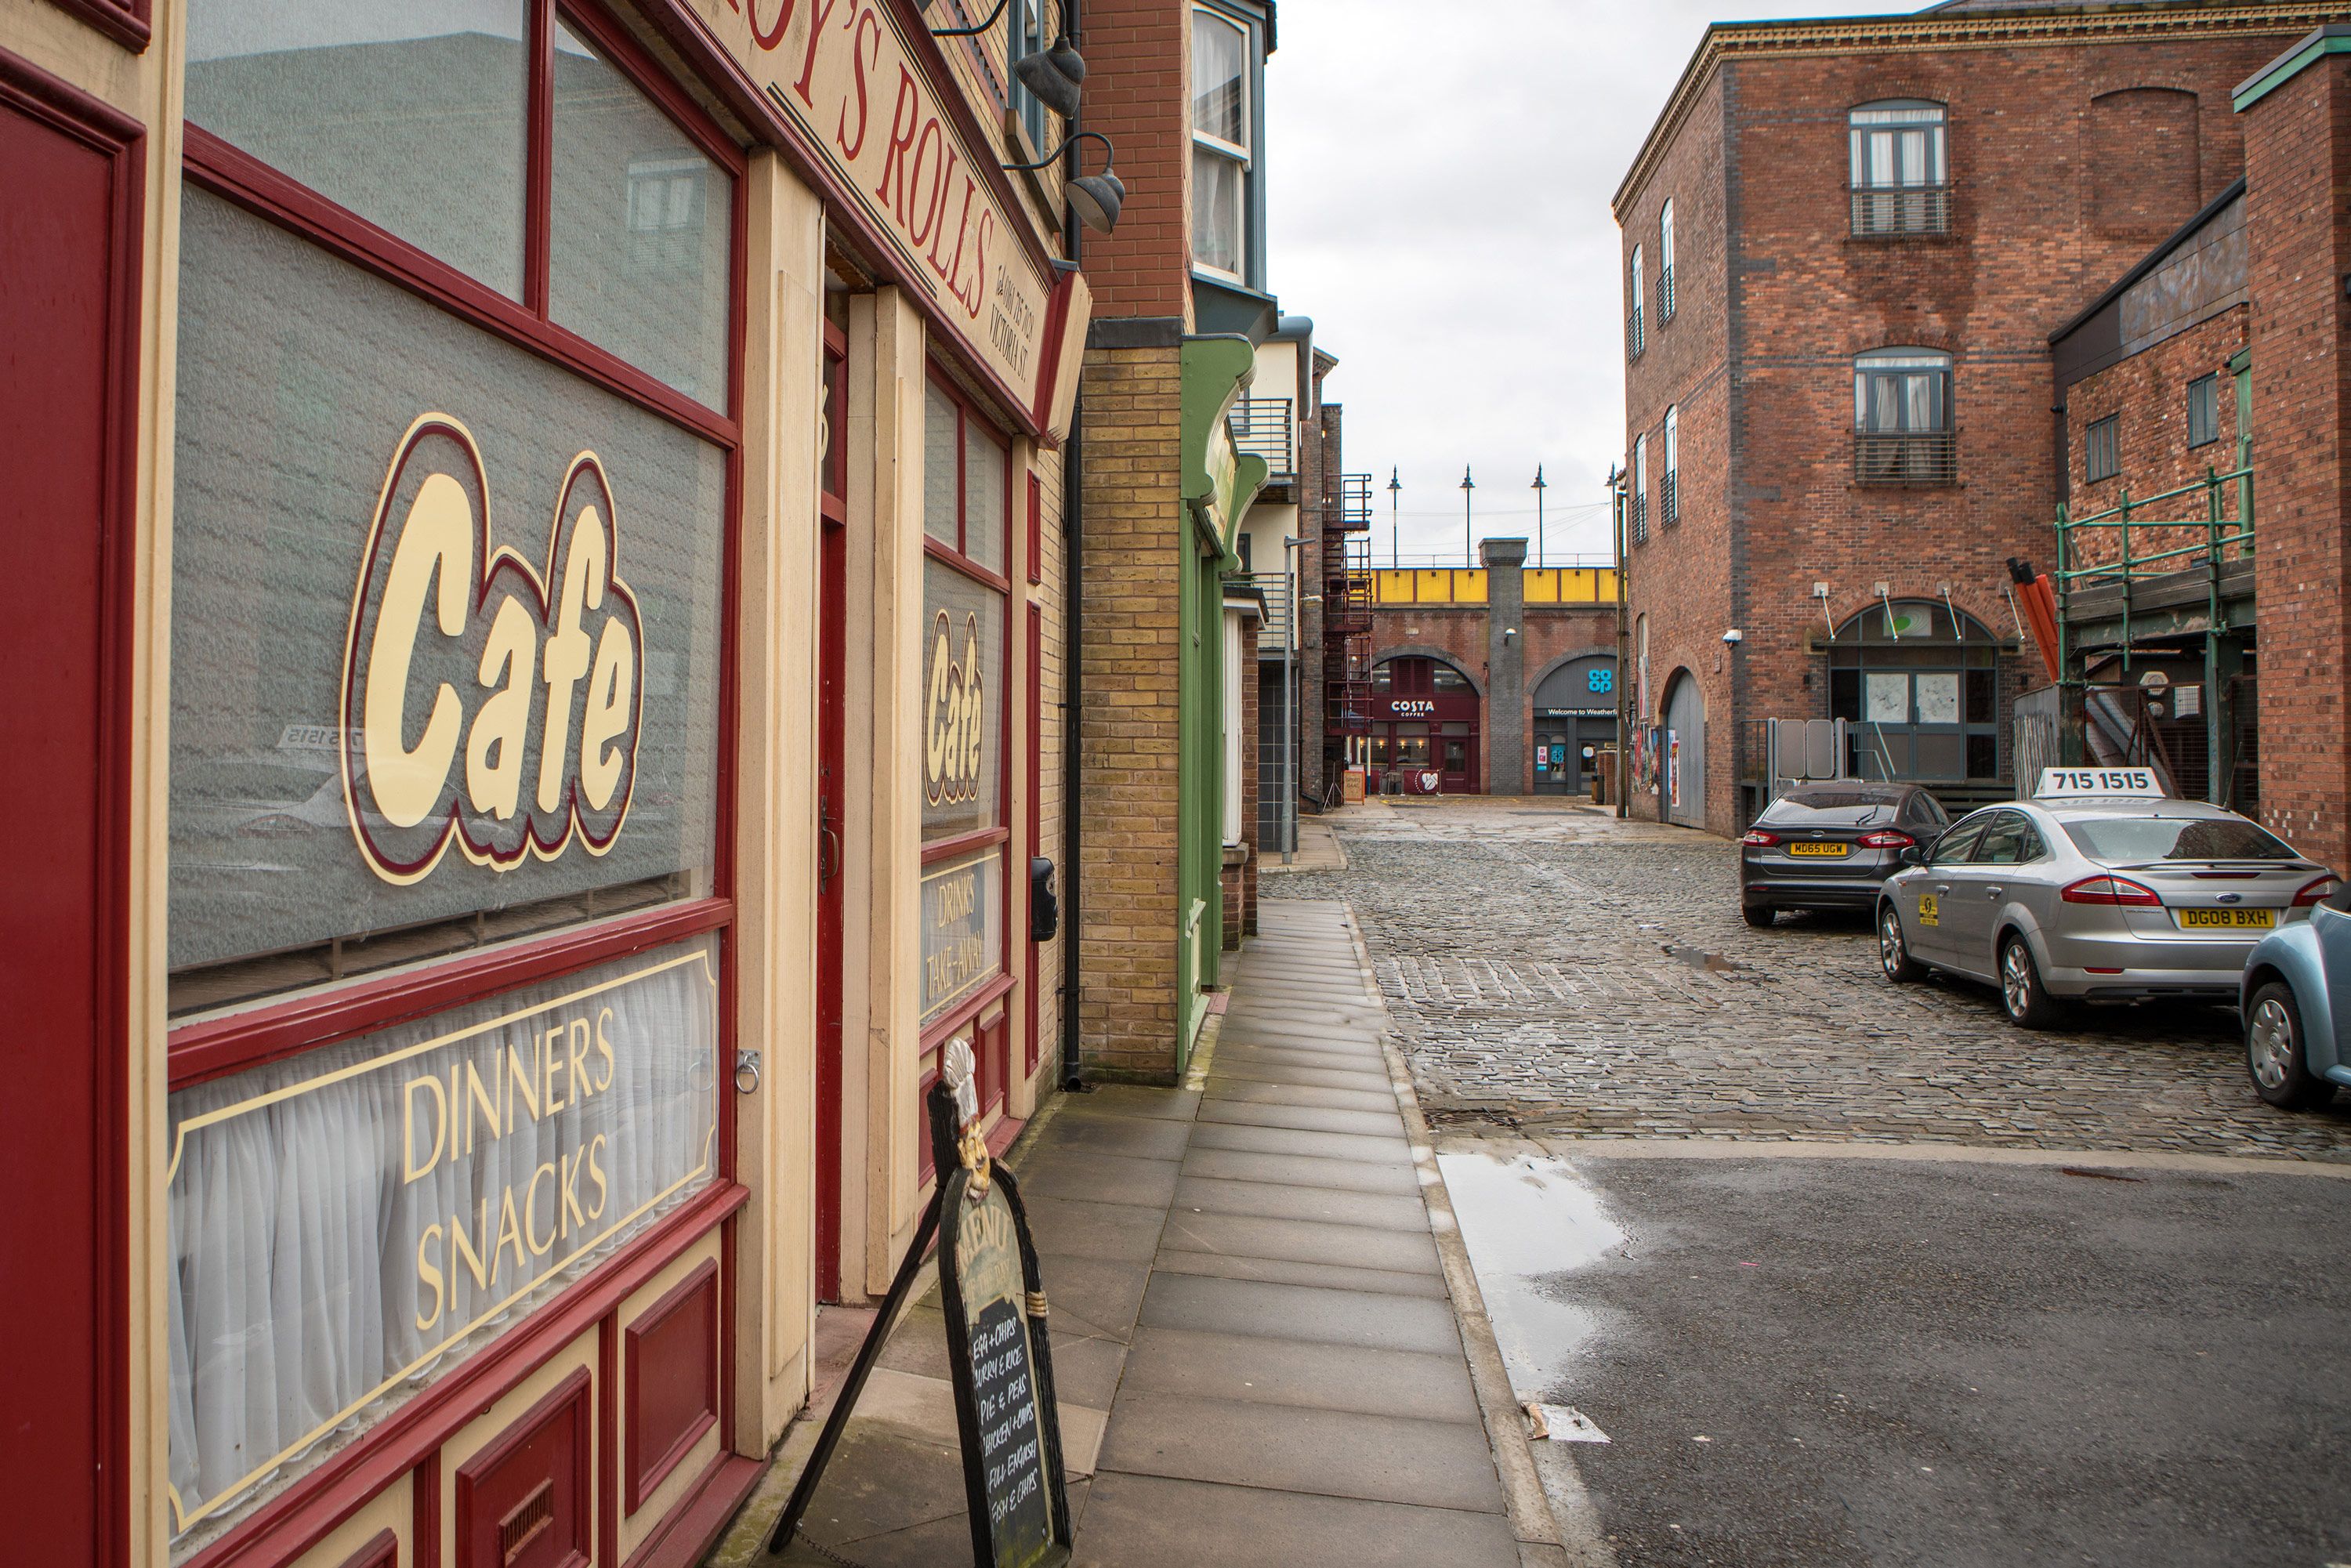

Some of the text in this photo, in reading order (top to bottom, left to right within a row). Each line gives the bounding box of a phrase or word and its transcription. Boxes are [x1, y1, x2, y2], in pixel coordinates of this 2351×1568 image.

[727, 0, 994, 320] Y'S ROLLS
[990, 302, 1019, 372] VICTORIA
[365, 473, 633, 828] Cafe
[927, 633, 982, 783] Cafe
[1391, 701, 1435, 712] COSTA
[2052, 773, 2149, 789] 715 1515
[1795, 844, 1842, 853] MD65 UGW
[938, 873, 975, 929] DRINKS
[2187, 910, 2268, 925] DG08 BXH
[926, 928, 984, 1000] TAKE-AWAY
[404, 1006, 615, 1185] DINNERS
[415, 1133, 607, 1331] SNACKS
[958, 1204, 1010, 1278] MENU
[973, 1332, 988, 1361] EGG
[994, 1316, 1016, 1347] CHIPS
[998, 1355, 1005, 1376] &
[1005, 1344, 1023, 1371] RICE
[980, 1373, 1027, 1426] PIE & PEAS
[1017, 1401, 1034, 1429] CHIPS
[989, 1438, 1037, 1494] FULL ENGLISH
[991, 1467, 1038, 1523] FISH & CHIPS
